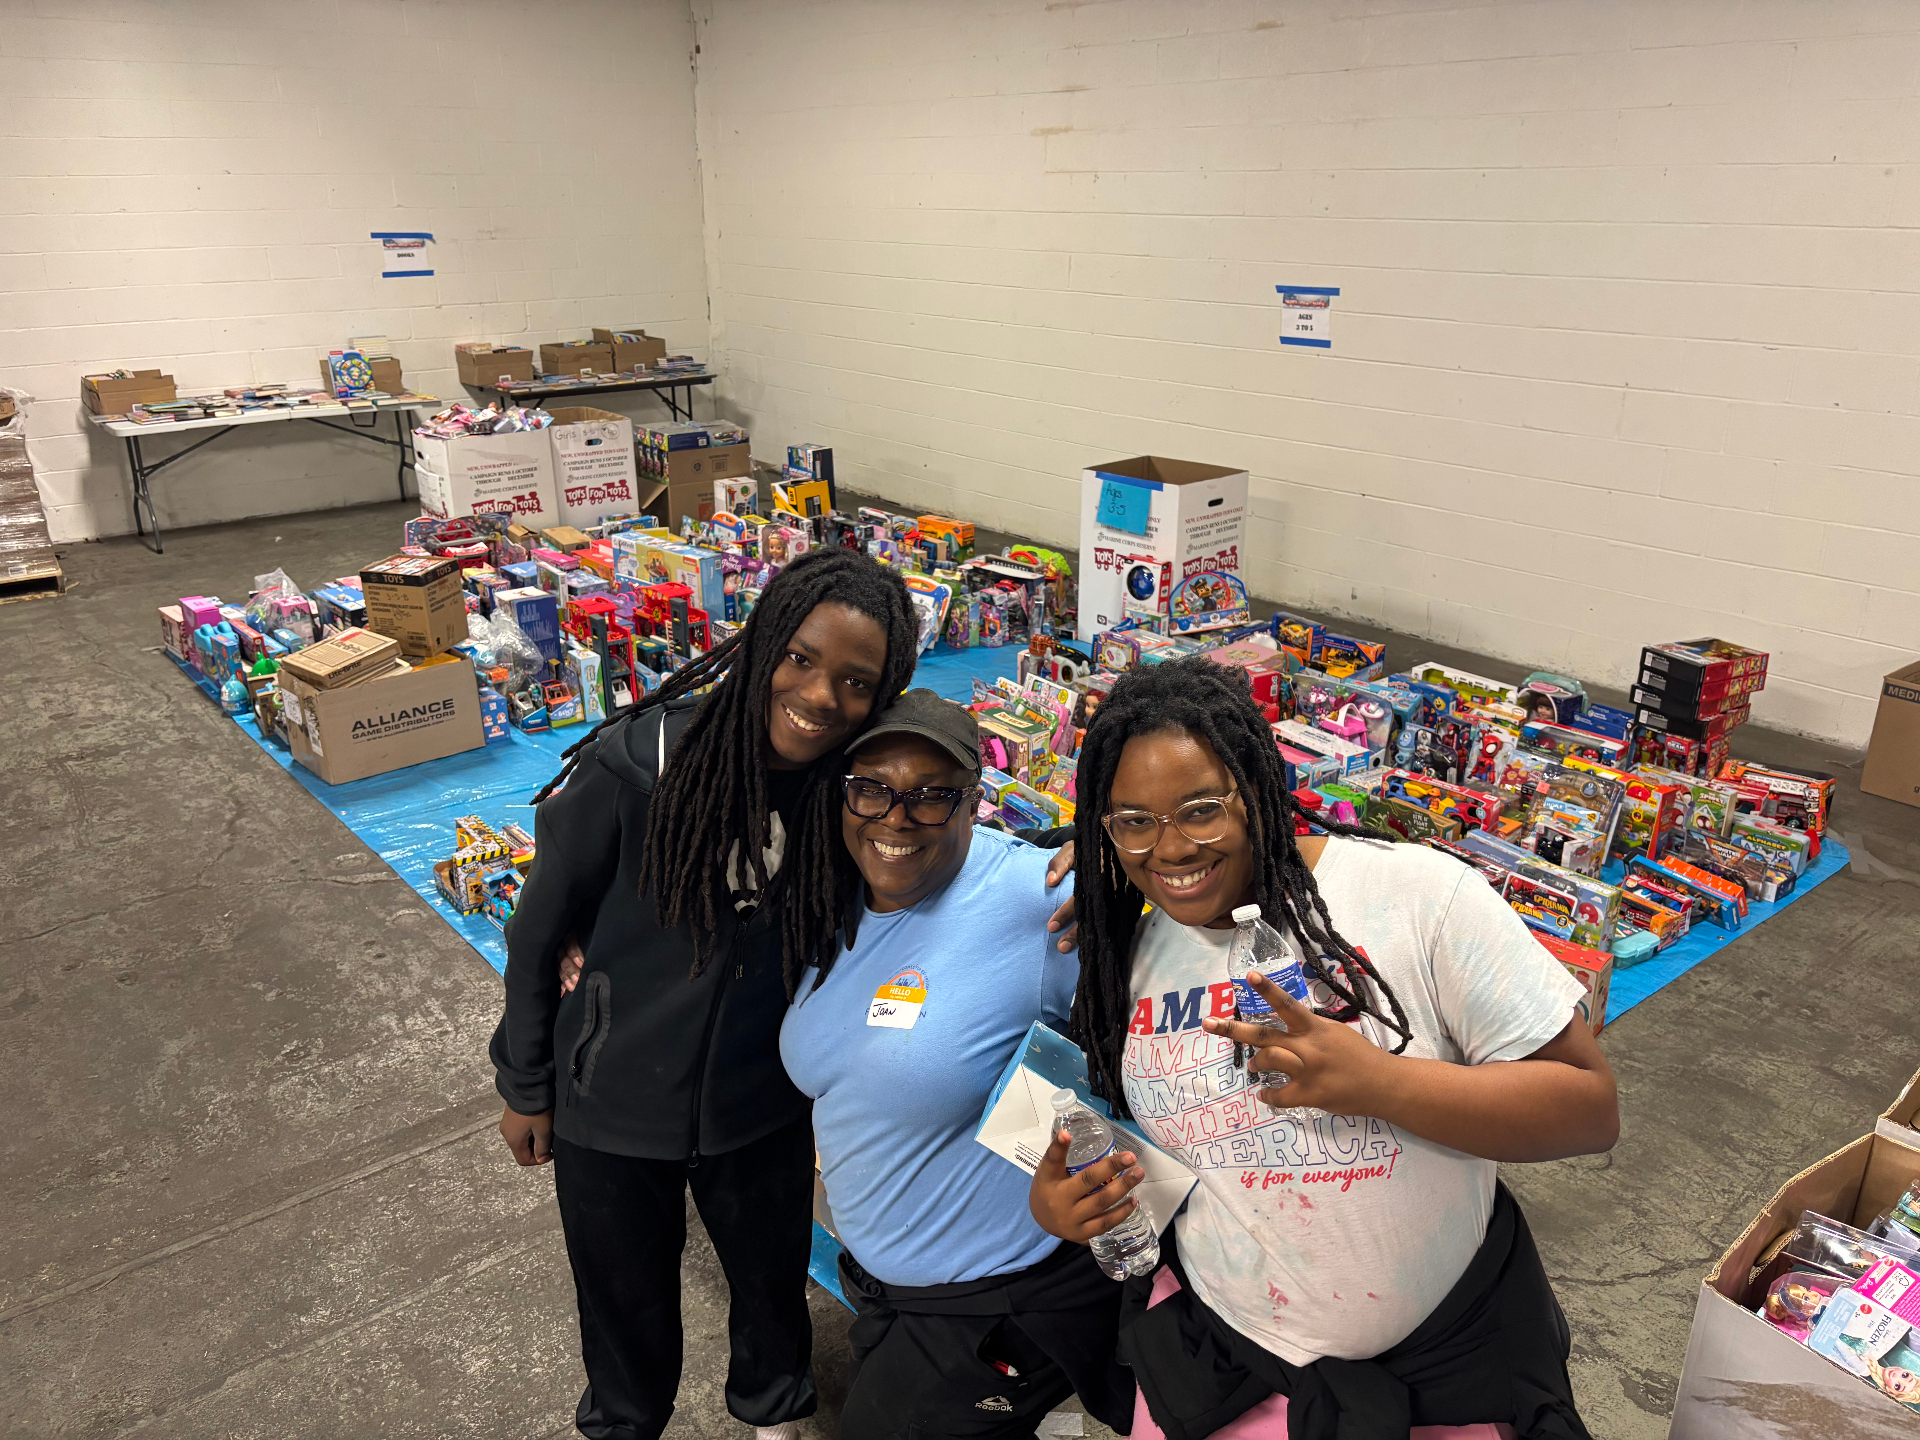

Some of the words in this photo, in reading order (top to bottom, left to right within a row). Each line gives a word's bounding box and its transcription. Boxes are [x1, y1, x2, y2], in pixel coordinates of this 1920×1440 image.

[470, 472, 497, 480] CAMPAIGN
[508, 473, 534, 481] DECEMBER
[567, 490, 586, 500] TOYS
[590, 490, 604, 498] FOR
[608, 487, 627, 496] TOTS
[1106, 483, 1122, 501] Ages
[474, 502, 495, 514] TOYS
[499, 502, 514, 511] FOR
[518, 500, 538, 509] TOTS
[1108, 502, 1126, 515] 3-5
[1186, 524, 1208, 533] CAMPAIGN
[1190, 530, 1211, 540] THROUGH
[1216, 524, 1237, 533] DECEMBER
[1104, 535, 1121, 543] MARINE
[1122, 539, 1136, 547] CORPS
[1137, 542, 1156, 551] RESERVE
[1096, 551, 1112, 564] TOYS
[436, 564, 452, 577] TOYS
[1184, 561, 1201, 576] TOYS
[1204, 561, 1216, 570] FOR
[1220, 555, 1235, 565] TOTS
[382, 574, 404, 584] TOYS
[1888, 686, 1920, 703] MEDI
[352, 698, 455, 732] ALLIANCE
[352, 728, 382, 739] GAME
[384, 710, 455, 732] DISTRIBUTORS
[1746, 836, 1787, 850] ALPHABET
[1710, 844, 1741, 857] MONSTER
[890, 987, 911, 996] HELLO
[1240, 1170, 1258, 1189] is
[1262, 1169, 1295, 1190] for
[1302, 1148, 1398, 1193] everyone!
[1868, 1314, 1892, 1346] FROZEN
[975, 1402, 1014, 1412] Reebok
